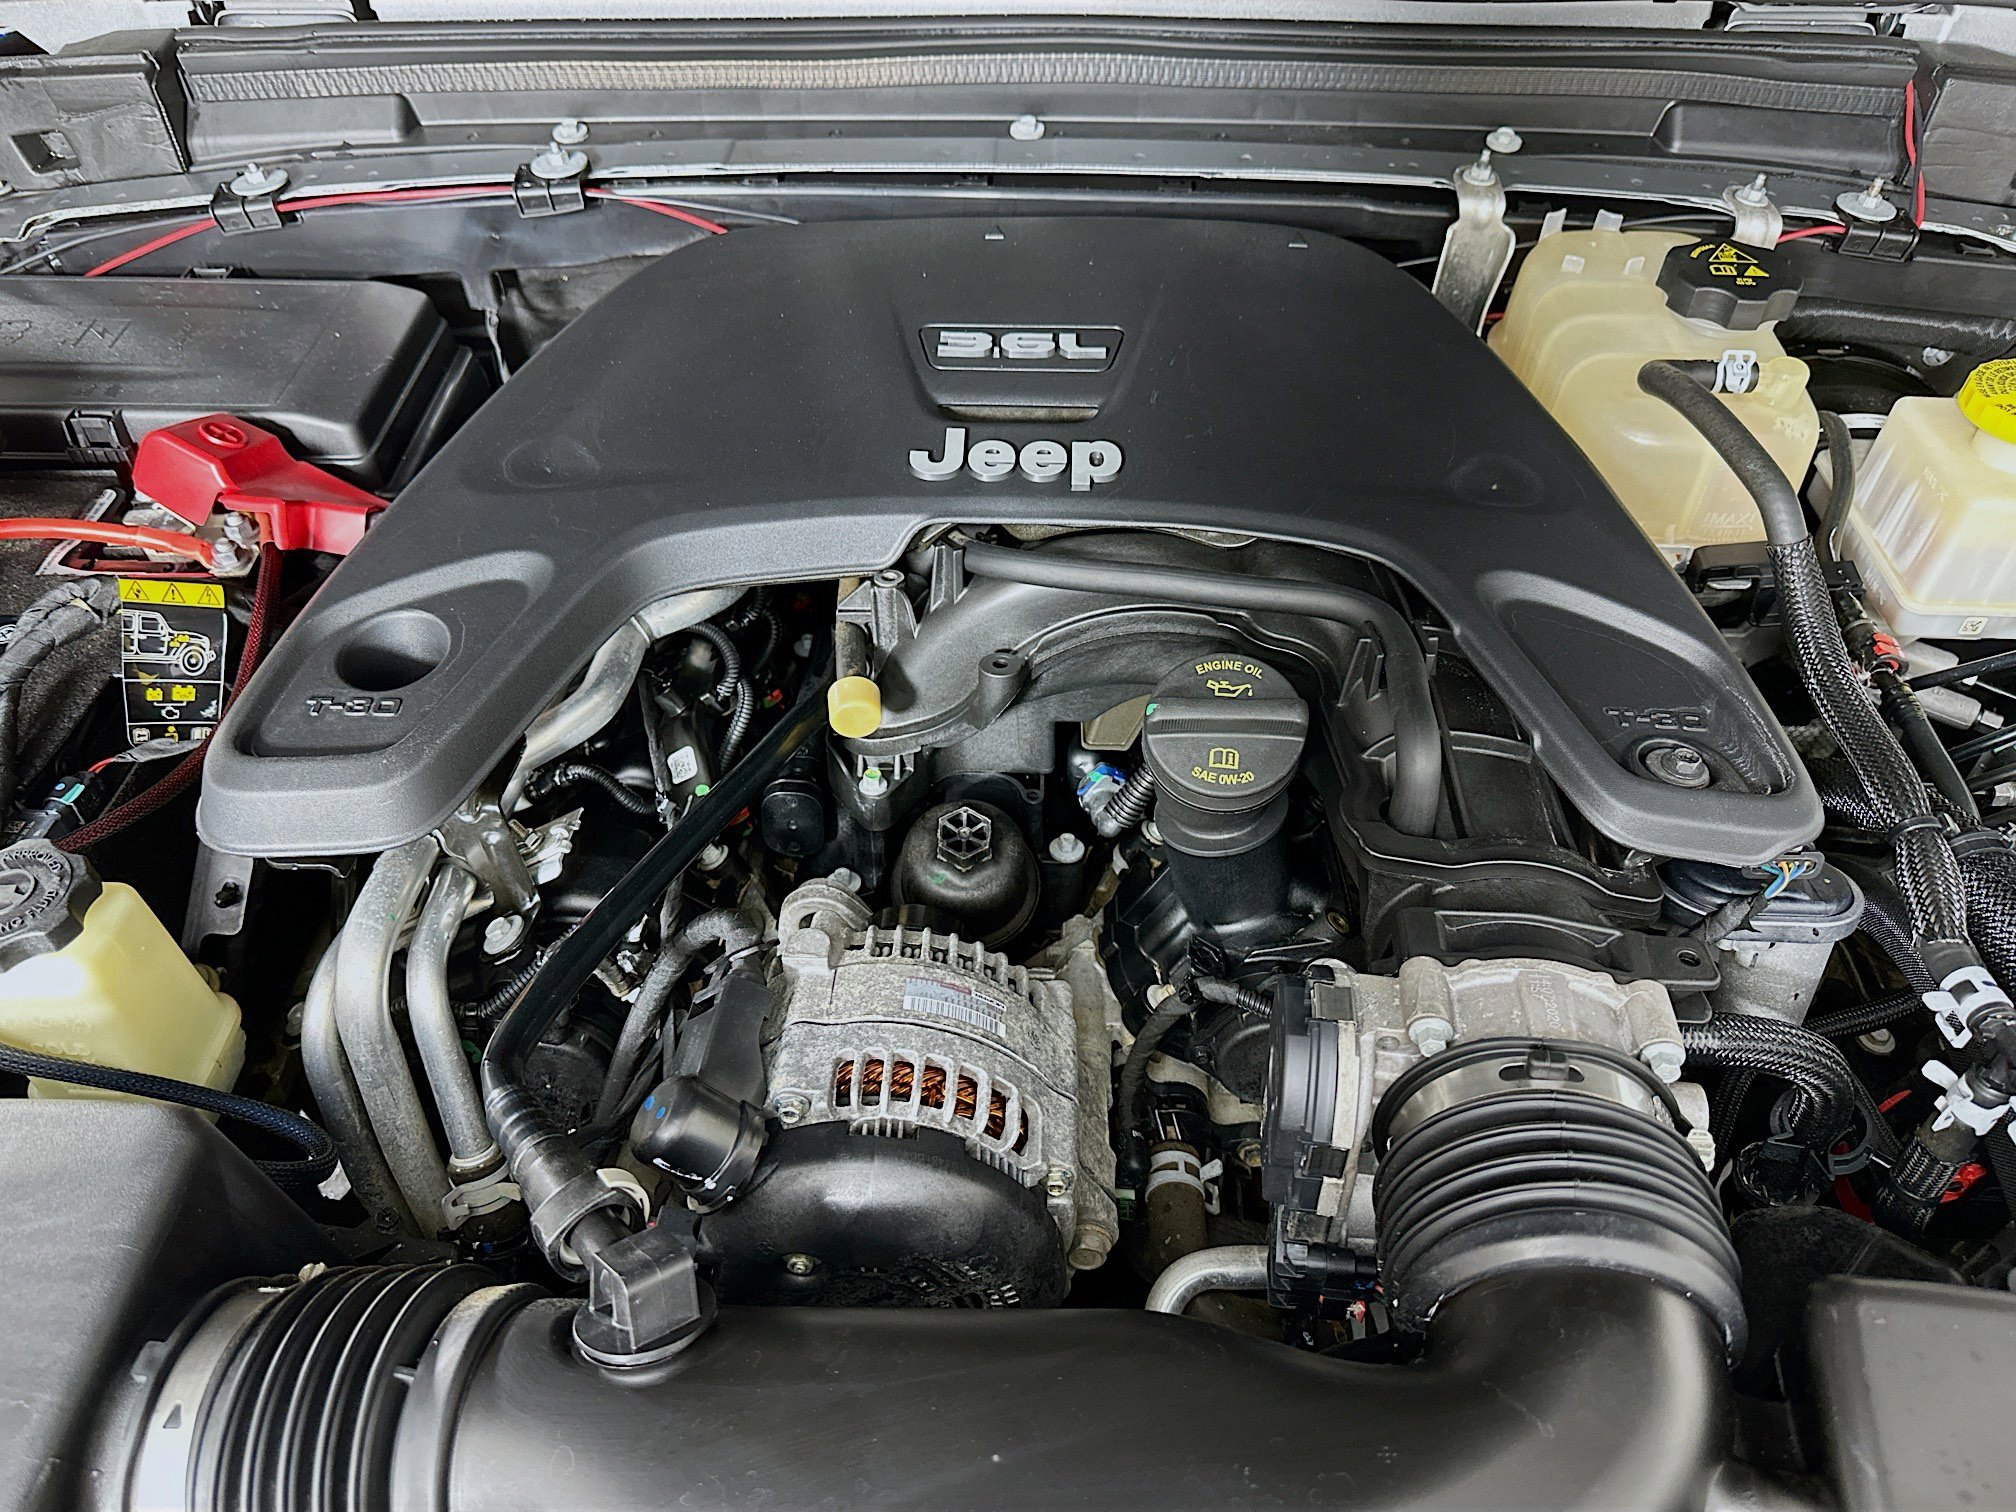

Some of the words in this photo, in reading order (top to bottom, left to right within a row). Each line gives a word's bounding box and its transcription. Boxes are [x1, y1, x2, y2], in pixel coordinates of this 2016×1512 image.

[937, 330, 1107, 360] 3.6L
[908, 427, 1123, 492] Jeep
[1195, 660, 1243, 675] ENGINE
[1244, 664, 1264, 680] OIL
[306, 695, 404, 717] T-30
[1191, 766, 1217, 784] SAE
[1218, 771, 1255, 785] 0W-20
